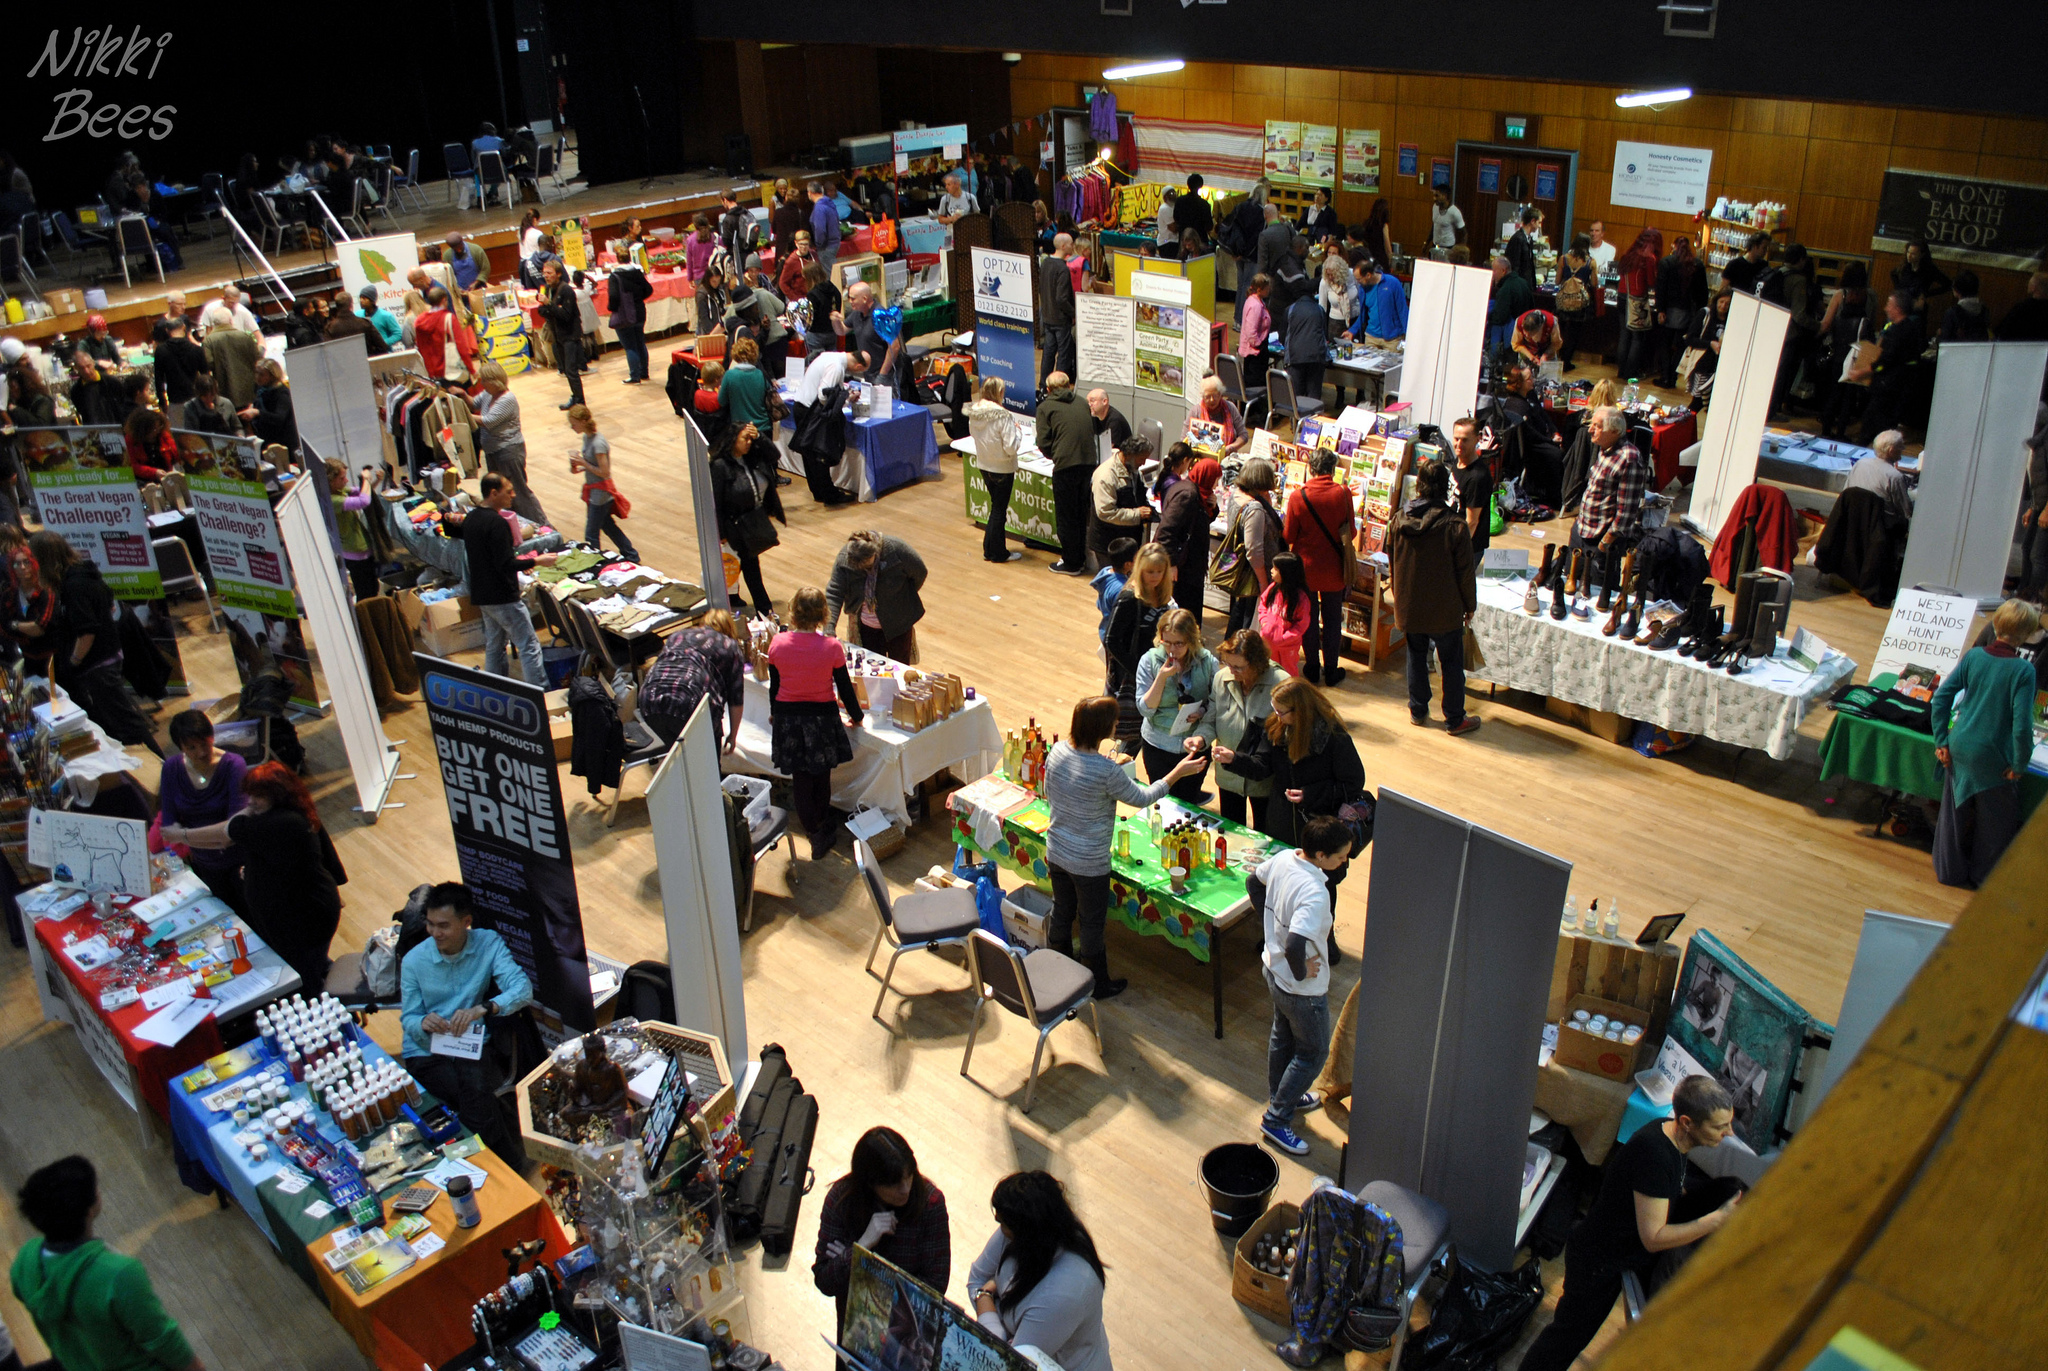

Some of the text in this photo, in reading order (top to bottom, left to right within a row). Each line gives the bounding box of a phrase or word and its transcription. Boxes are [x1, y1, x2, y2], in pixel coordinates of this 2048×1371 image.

[1648, 153, 1703, 164] Honesty Cosmetics
[1933, 183, 2008, 207] THE ONE
[1930, 200, 2004, 226] EARTH
[1924, 219, 1998, 247] SHOP
[983, 256, 1025, 276] OPT2XL
[977, 300, 1028, 318] 0121 632 2120
[977, 317, 1030, 335] World class trainings:
[979, 335, 989, 345] NLP
[1138, 332, 1168, 344] Green Party
[980, 354, 1013, 370] NLP Coaching
[36, 473, 52, 484] Are
[55, 474, 73, 486] you
[75, 472, 102, 484] ready
[190, 476, 204, 488] Are
[205, 480, 220, 491] you
[220, 480, 243, 495] ready
[40, 491, 135, 506] The Great Vegan
[194, 494, 269, 521] The Great Vegan
[45, 507, 131, 527] Challenge?
[199, 511, 266, 540] Challenge?
[82, 532, 96, 540] help
[123, 574, 140, 584] and
[222, 567, 246, 577] November
[132, 586, 159, 598] today!
[217, 581, 277, 599] Find out more and
[254, 600, 270, 609] here
[270, 602, 292, 615] today!
[1918, 597, 1953, 612] WEST
[1895, 608, 1966, 630] MIDLANDS
[1907, 625, 1944, 641] HUNT
[1881, 636, 1961, 660] SABOTEURS
[433, 681, 531, 726] yaoh
[430, 711, 545, 756] YAOH HEMP PRODUCTS
[434, 733, 550, 793] BUY ONE
[441, 760, 554, 818] GET ONE
[445, 785, 561, 860] FREE
[478, 850, 525, 873] BODYCARE
[485, 890, 511, 904] FOOD
[495, 920, 532, 942] VEGAN
[1658, 1058, 1676, 1085] Vegan
[1672, 1060, 1678, 1070] a
[956, 1330, 1005, 1371] Witches'
